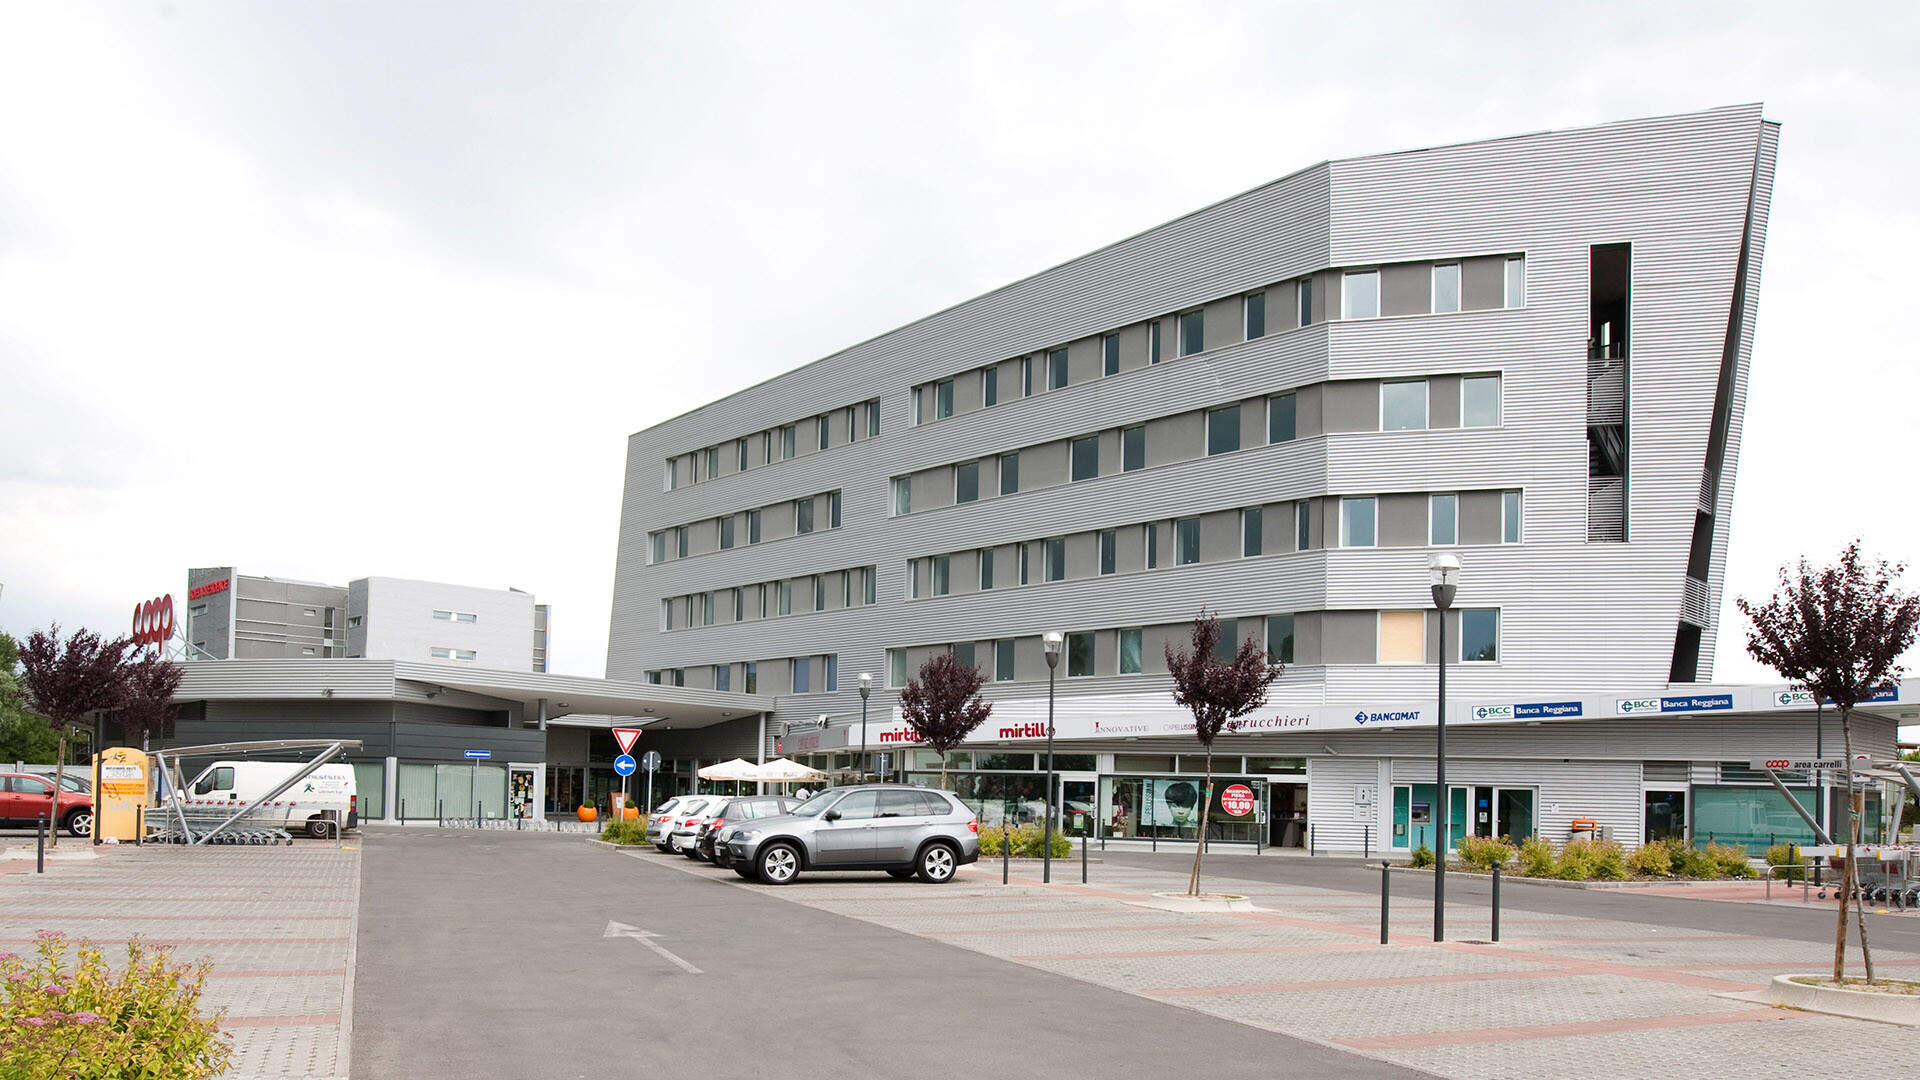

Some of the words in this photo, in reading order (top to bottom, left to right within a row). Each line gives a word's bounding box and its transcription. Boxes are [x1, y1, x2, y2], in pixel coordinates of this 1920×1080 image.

[133, 593, 173, 653] coop
[1634, 700, 1658, 708] BCC
[1663, 700, 1688, 708] Banca
[1691, 698, 1729, 709] Reggiana
[1488, 706, 1511, 714] BCC
[1543, 705, 1579, 714] Reggiana
[1370, 711, 1420, 721] BANCOMAT
[1765, 759, 1790, 770] coop
[1794, 761, 1812, 769] area
[1813, 760, 1842, 769] carrelli
